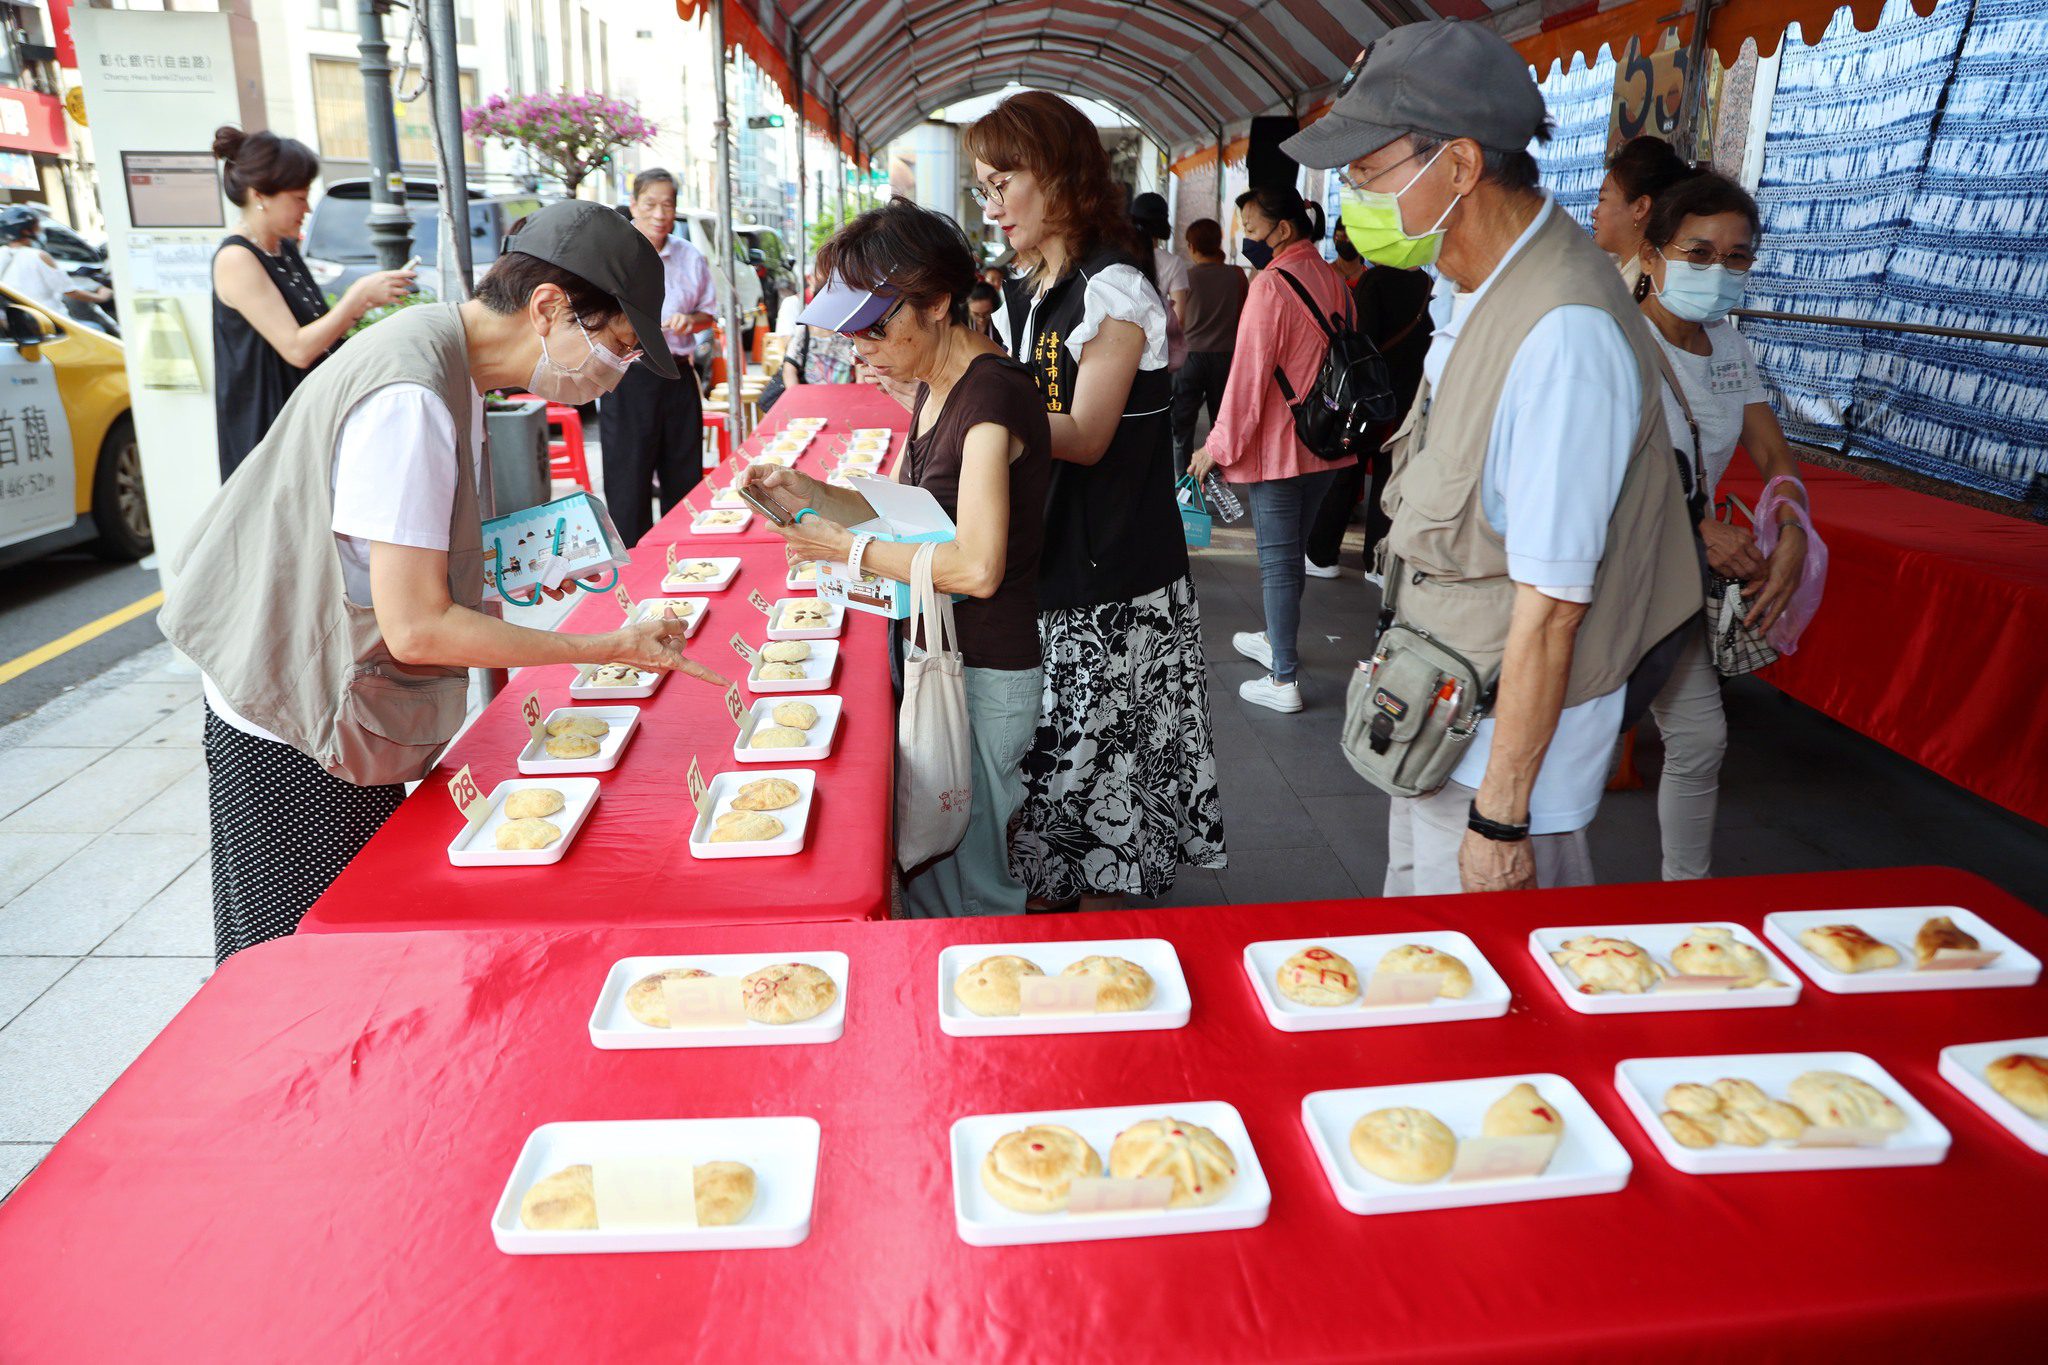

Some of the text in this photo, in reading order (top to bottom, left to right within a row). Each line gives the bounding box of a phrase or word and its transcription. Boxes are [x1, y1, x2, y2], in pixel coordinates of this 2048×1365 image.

[1045, 331, 1062, 412] 臺中市自由
[751, 593, 769, 612] 33
[733, 636, 752, 658] 31
[523, 696, 541, 727] 30
[728, 688, 743, 720] 29
[452, 773, 478, 811] 28
[689, 762, 703, 803] 27
